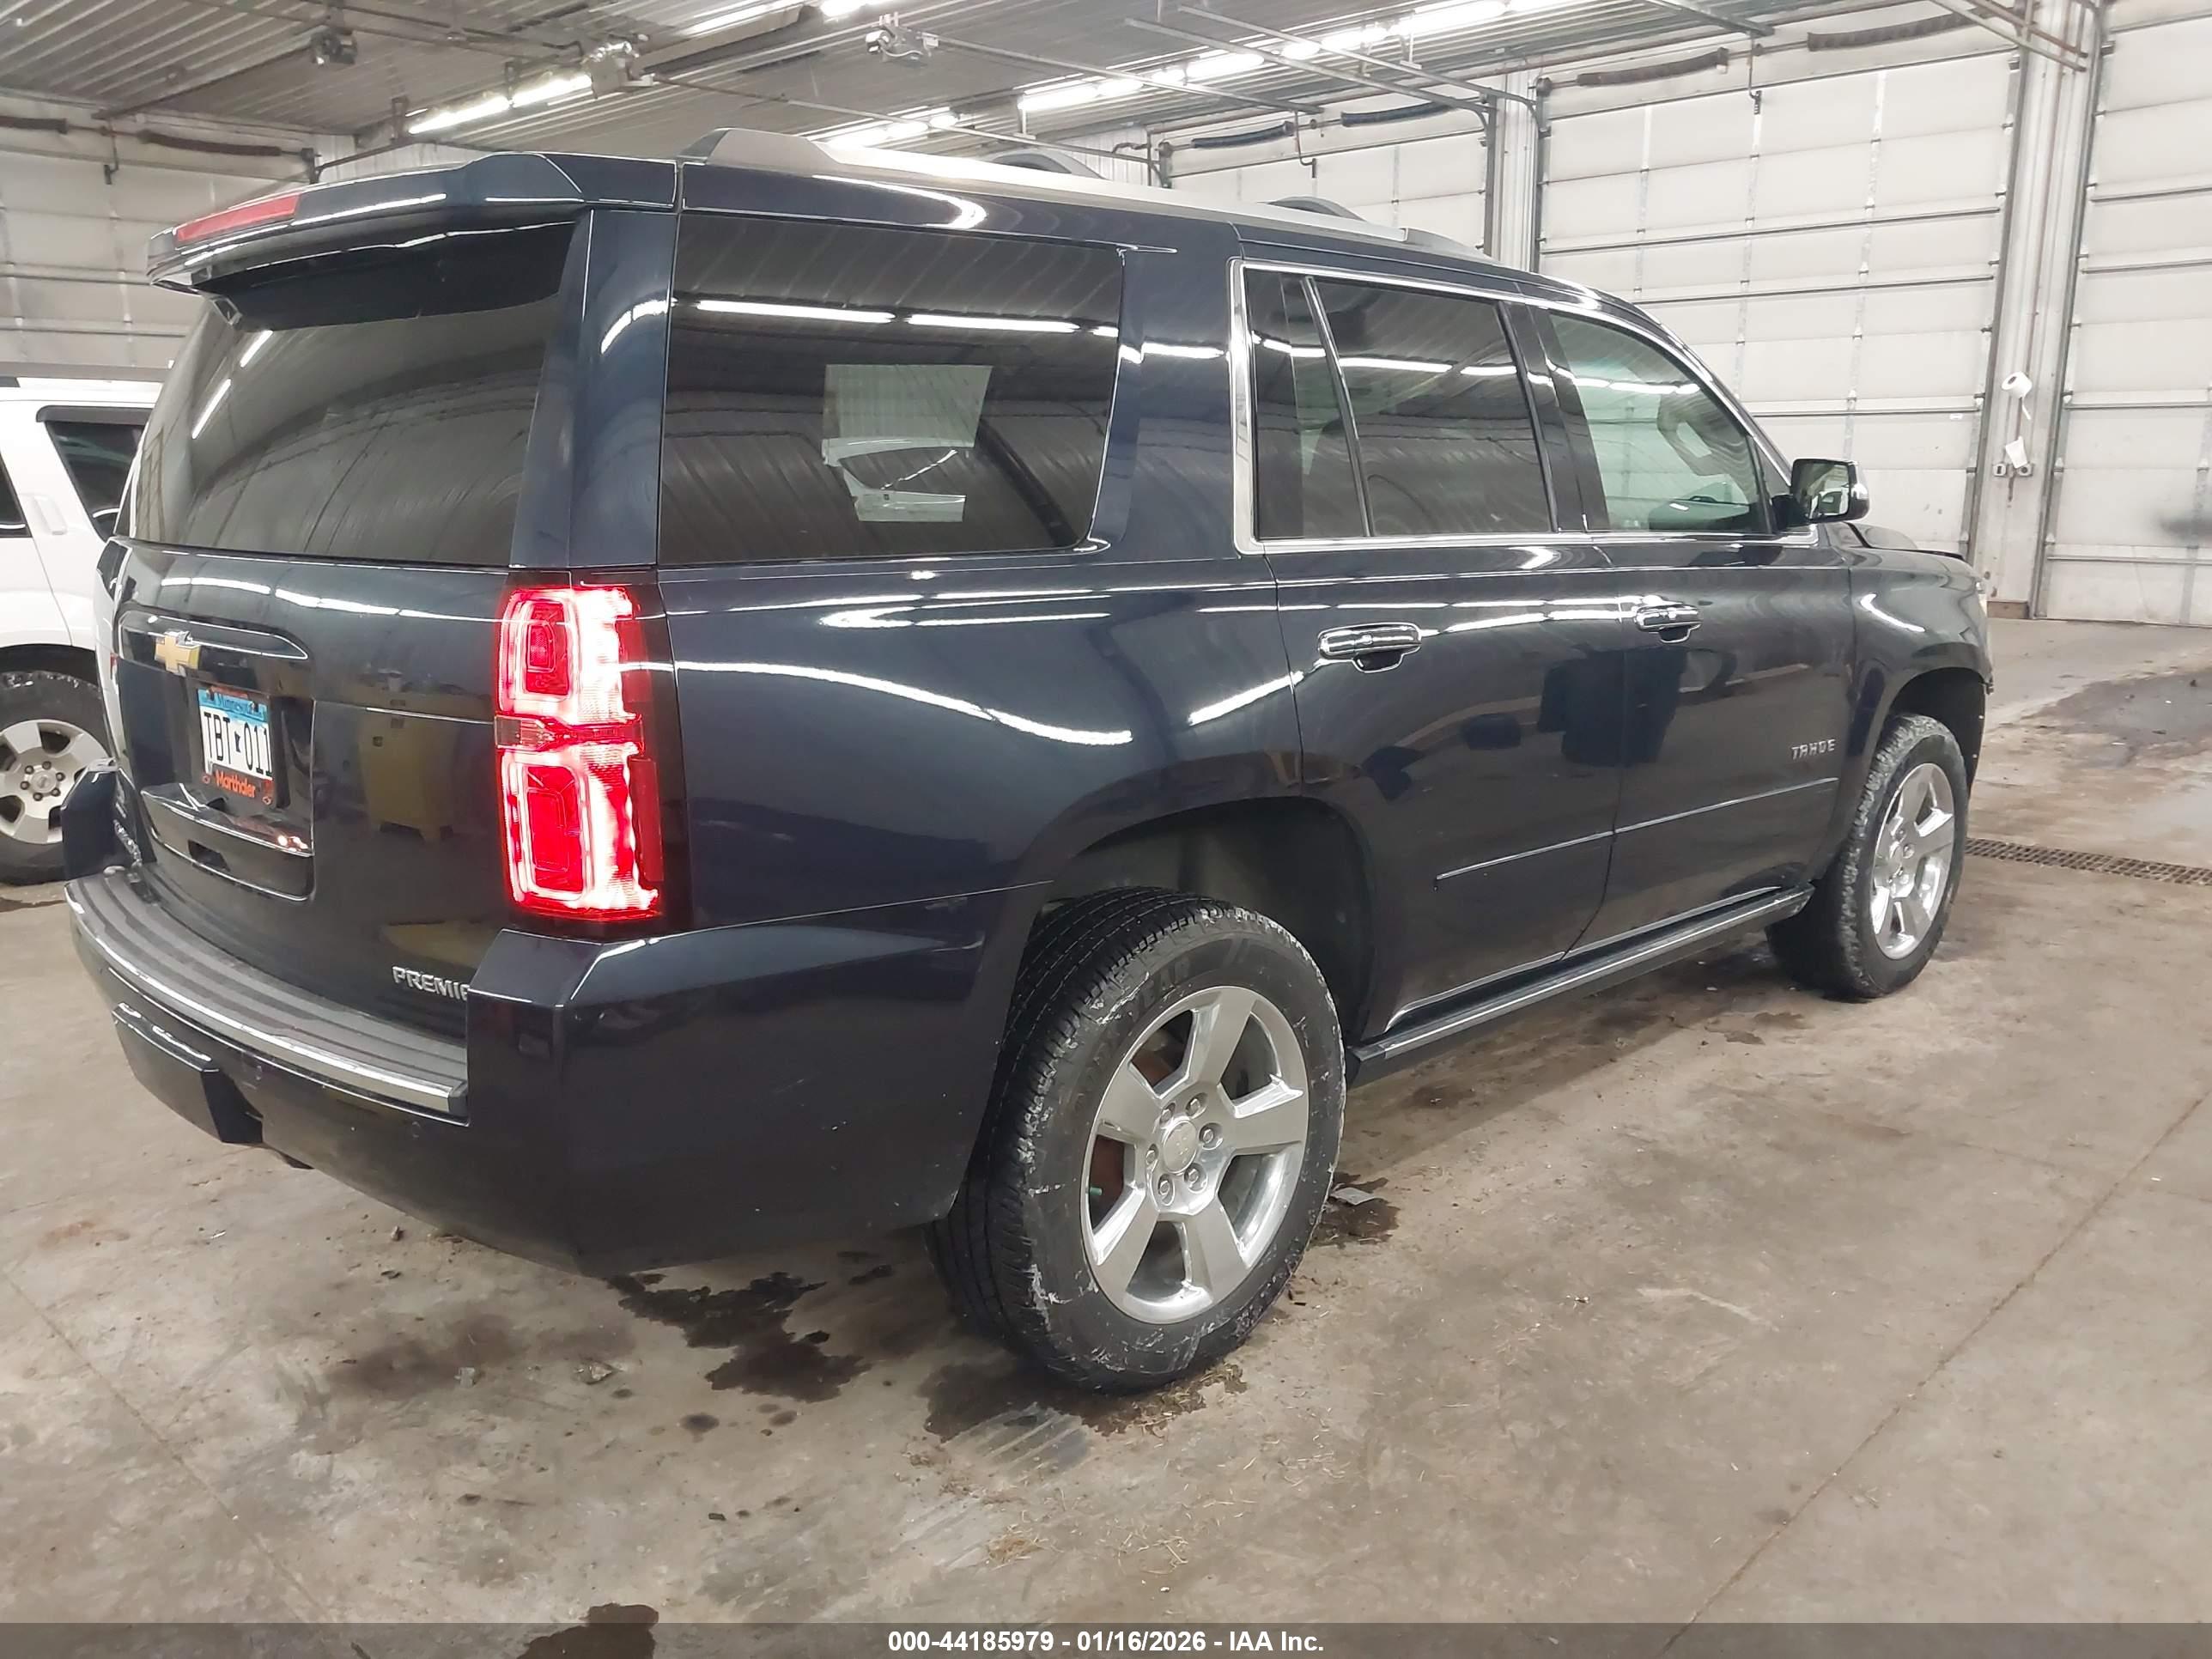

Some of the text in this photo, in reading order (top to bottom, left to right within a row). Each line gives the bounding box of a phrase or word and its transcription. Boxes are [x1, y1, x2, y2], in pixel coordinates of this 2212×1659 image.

[204, 712, 273, 777] TBT 011
[1791, 738, 1836, 760] TAHOE
[215, 769, 256, 798] Marthaler
[392, 966, 471, 1001] PREMIE
